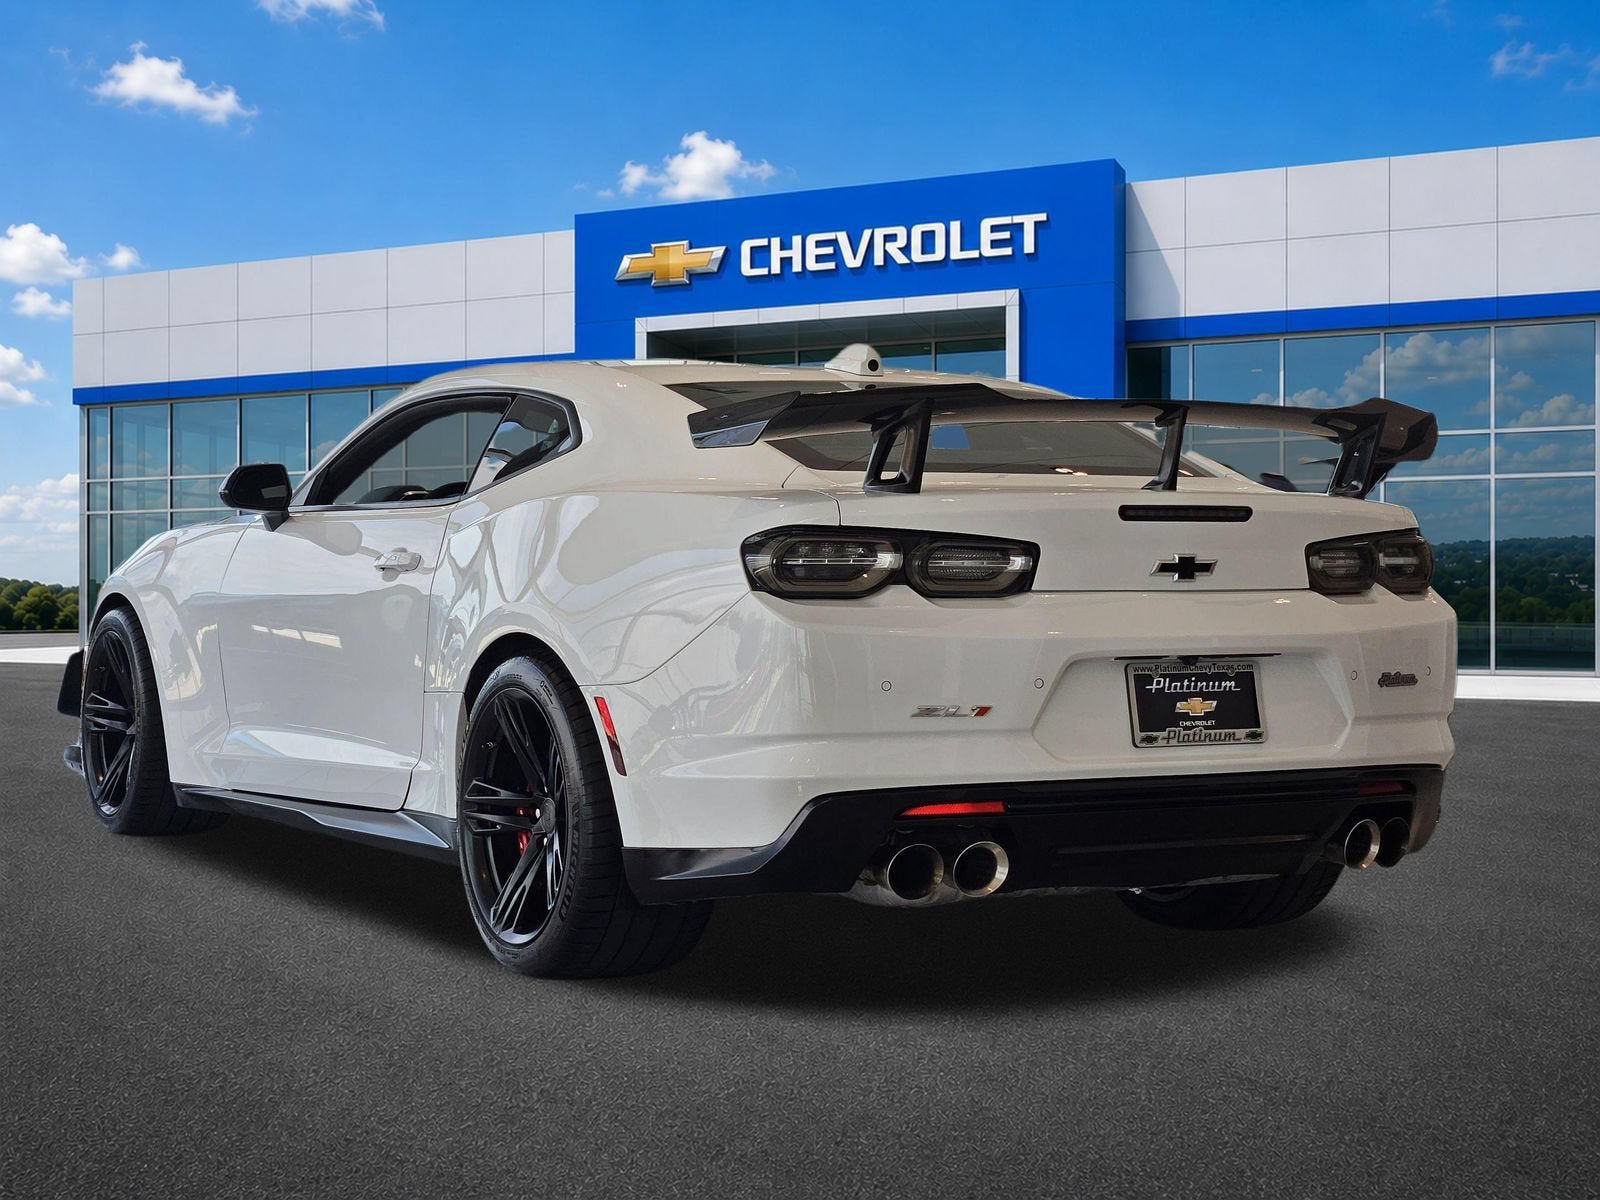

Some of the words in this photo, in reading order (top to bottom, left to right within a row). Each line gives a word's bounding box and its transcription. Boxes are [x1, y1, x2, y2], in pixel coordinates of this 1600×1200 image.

[740, 213, 1048, 277] CHEVROLET
[1133, 663, 1254, 674] www.PlatinumChevyTexas.com
[1145, 677, 1241, 693] Platinum
[911, 704, 992, 718] ZL1
[1161, 728, 1242, 744] Platinum
[559, 830, 580, 920] MICHELIN
